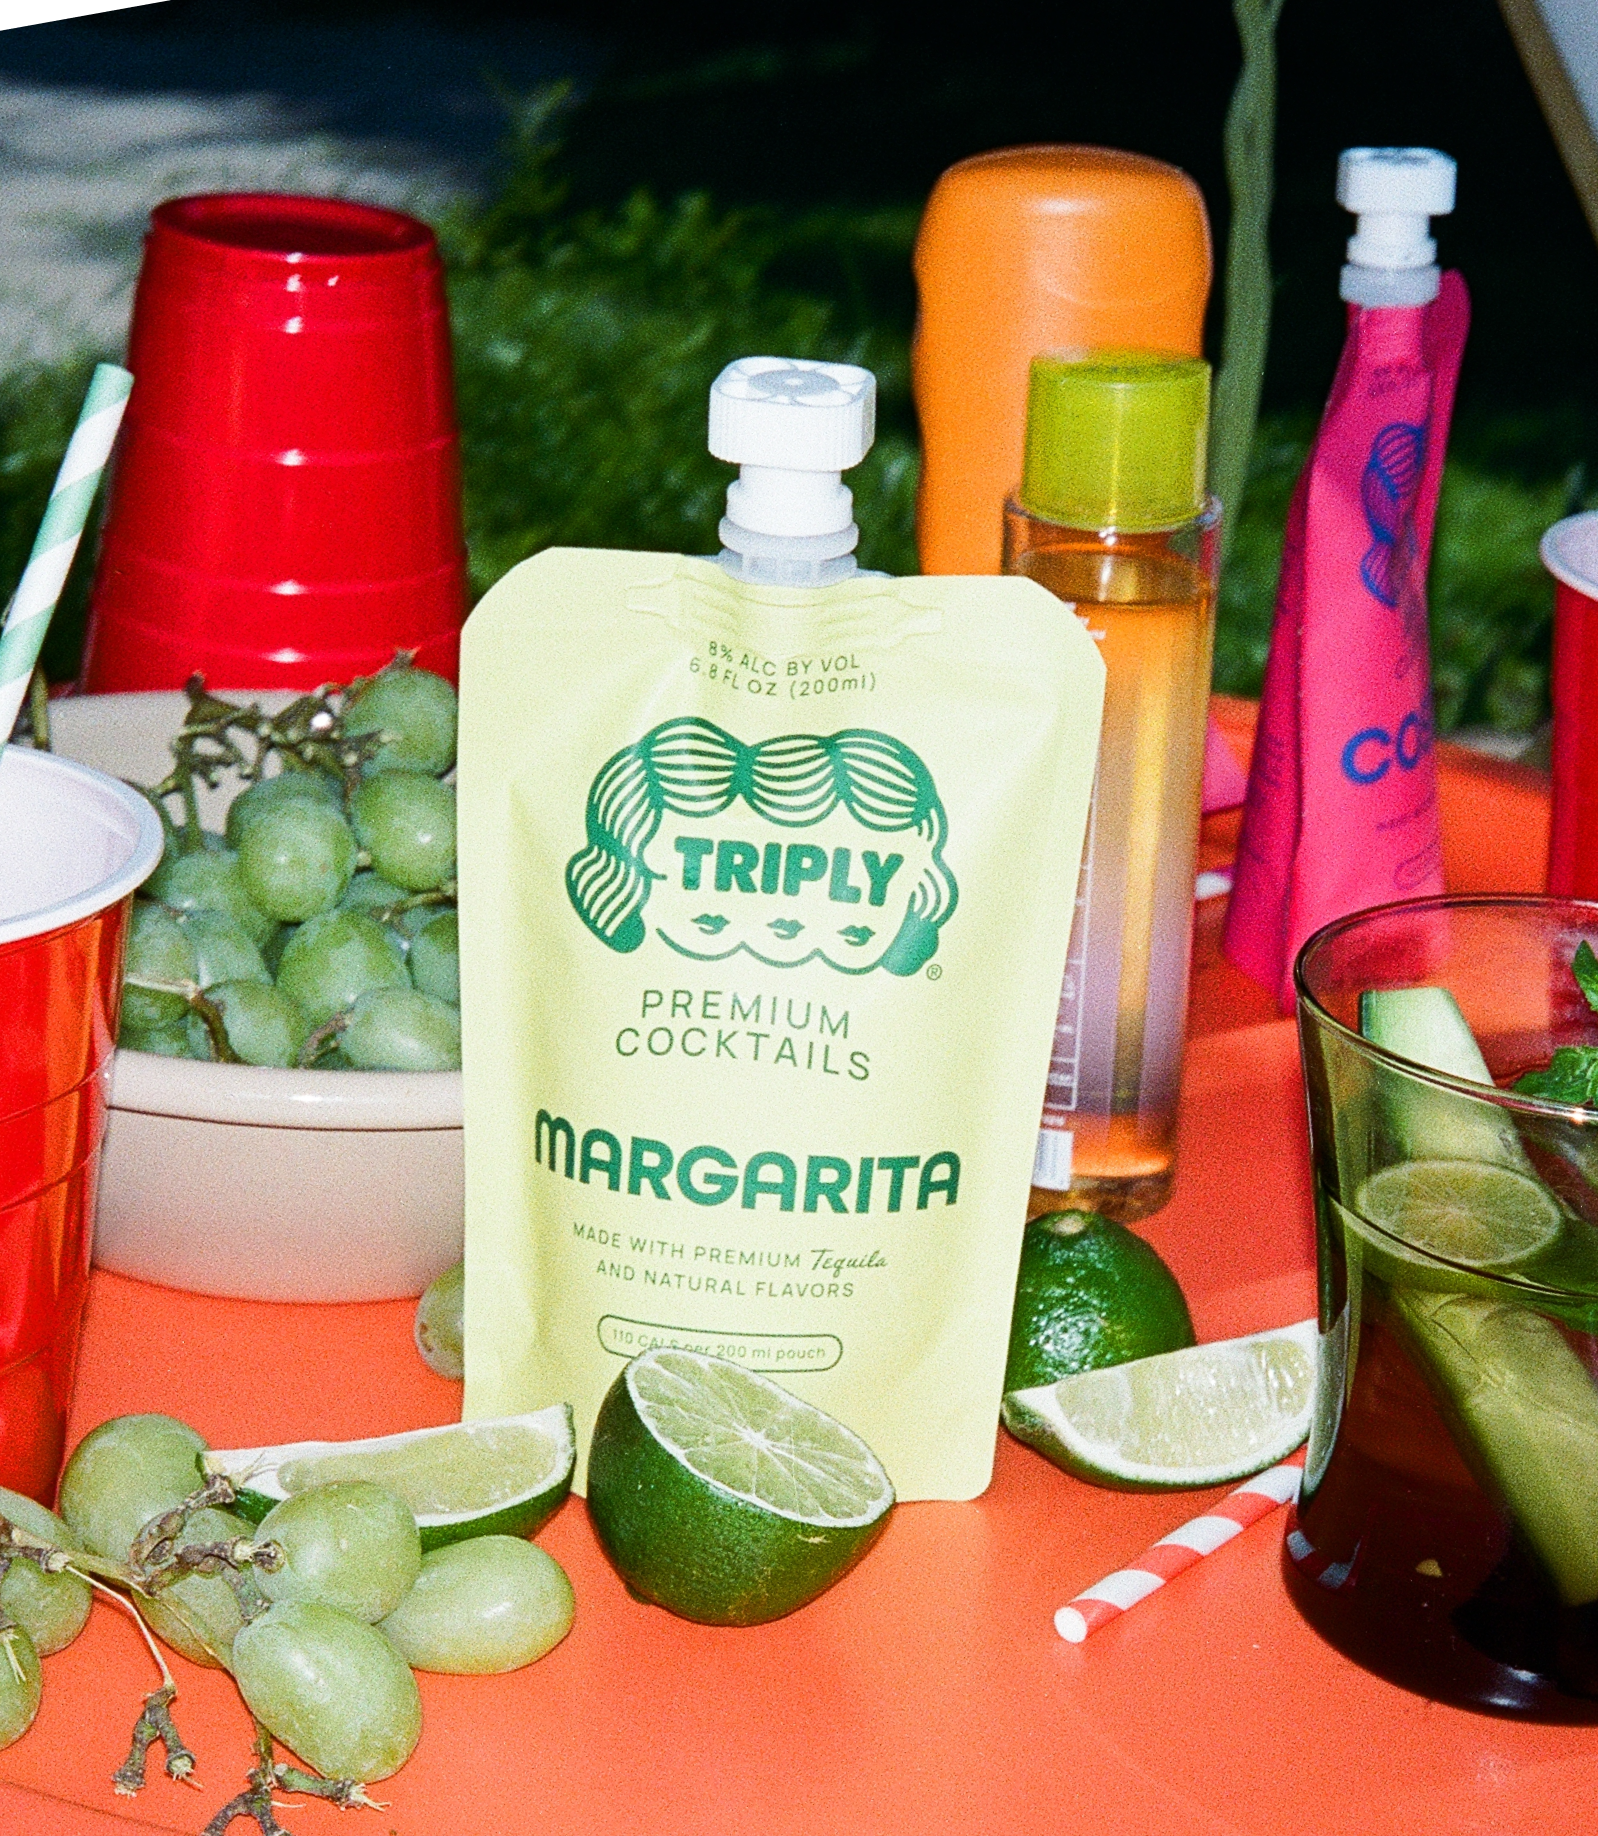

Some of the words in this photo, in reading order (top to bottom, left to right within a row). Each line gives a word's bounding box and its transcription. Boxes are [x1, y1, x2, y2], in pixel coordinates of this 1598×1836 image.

[689, 657, 718, 680] 6.8
[723, 669, 740, 690] FL
[747, 679, 777, 696] OZ
[789, 672, 876, 700] (200ml)
[709, 640, 733, 663] 8%
[740, 653, 777, 677] ALC
[787, 660, 813, 676] BY
[821, 654, 860, 672] VOL
[674, 836, 904, 906] TRIPLY
[641, 990, 851, 1040] PREMIUM
[615, 1027, 871, 1081] COCKTAILS
[535, 1108, 961, 1214] MARGARITA
[573, 1222, 621, 1249] MADE
[629, 1235, 684, 1259] WITH
[694, 1246, 801, 1268] PREMIUM
[811, 1249, 888, 1278] Tequila
[596, 1259, 635, 1281] AND
[644, 1269, 746, 1296] NATURAL
[755, 1281, 855, 1298] FLAVORS
[717, 1345, 747, 1358] 200
[776, 1348, 826, 1362] pouch
